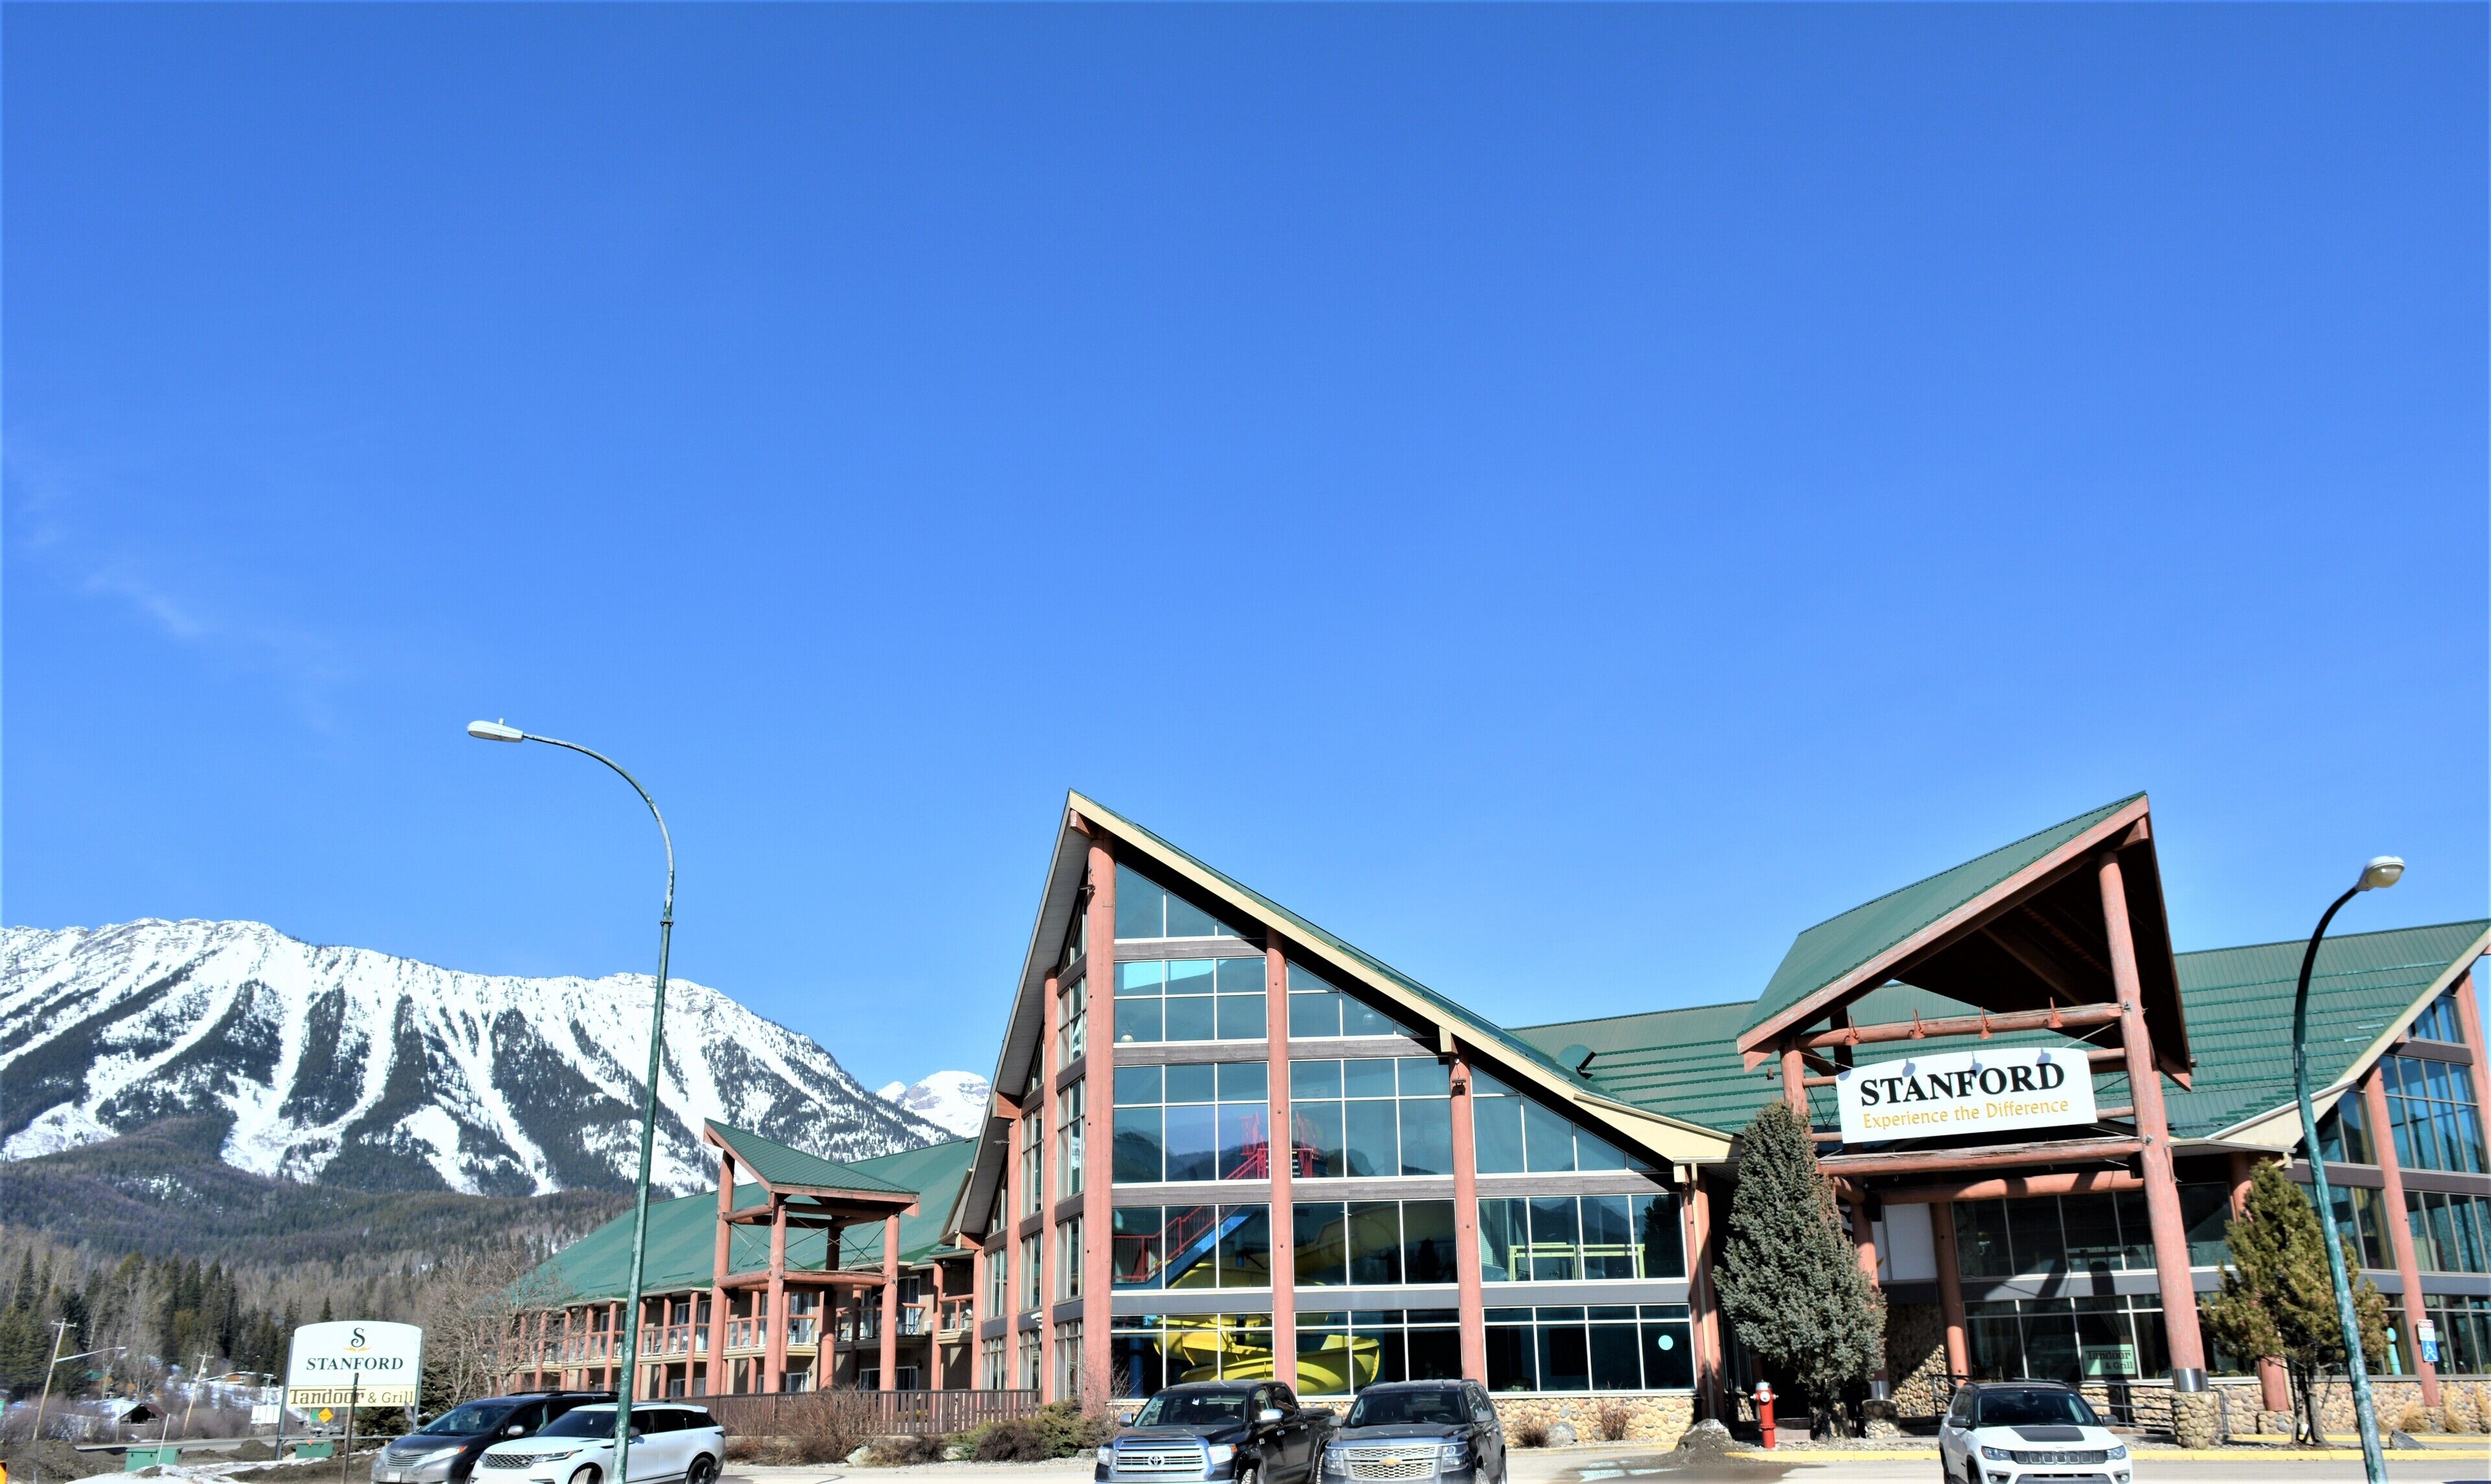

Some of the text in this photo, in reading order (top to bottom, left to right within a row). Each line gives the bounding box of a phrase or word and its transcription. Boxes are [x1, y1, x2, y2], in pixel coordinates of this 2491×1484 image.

[1860, 1062, 2064, 1107] STANFORD
[1864, 1100, 2069, 1130] Experience the Difference
[2086, 1350, 2131, 1359] Tandoor
[306, 1358, 403, 1370] STANFORD
[289, 1389, 413, 1404] Tandoor & Grill
